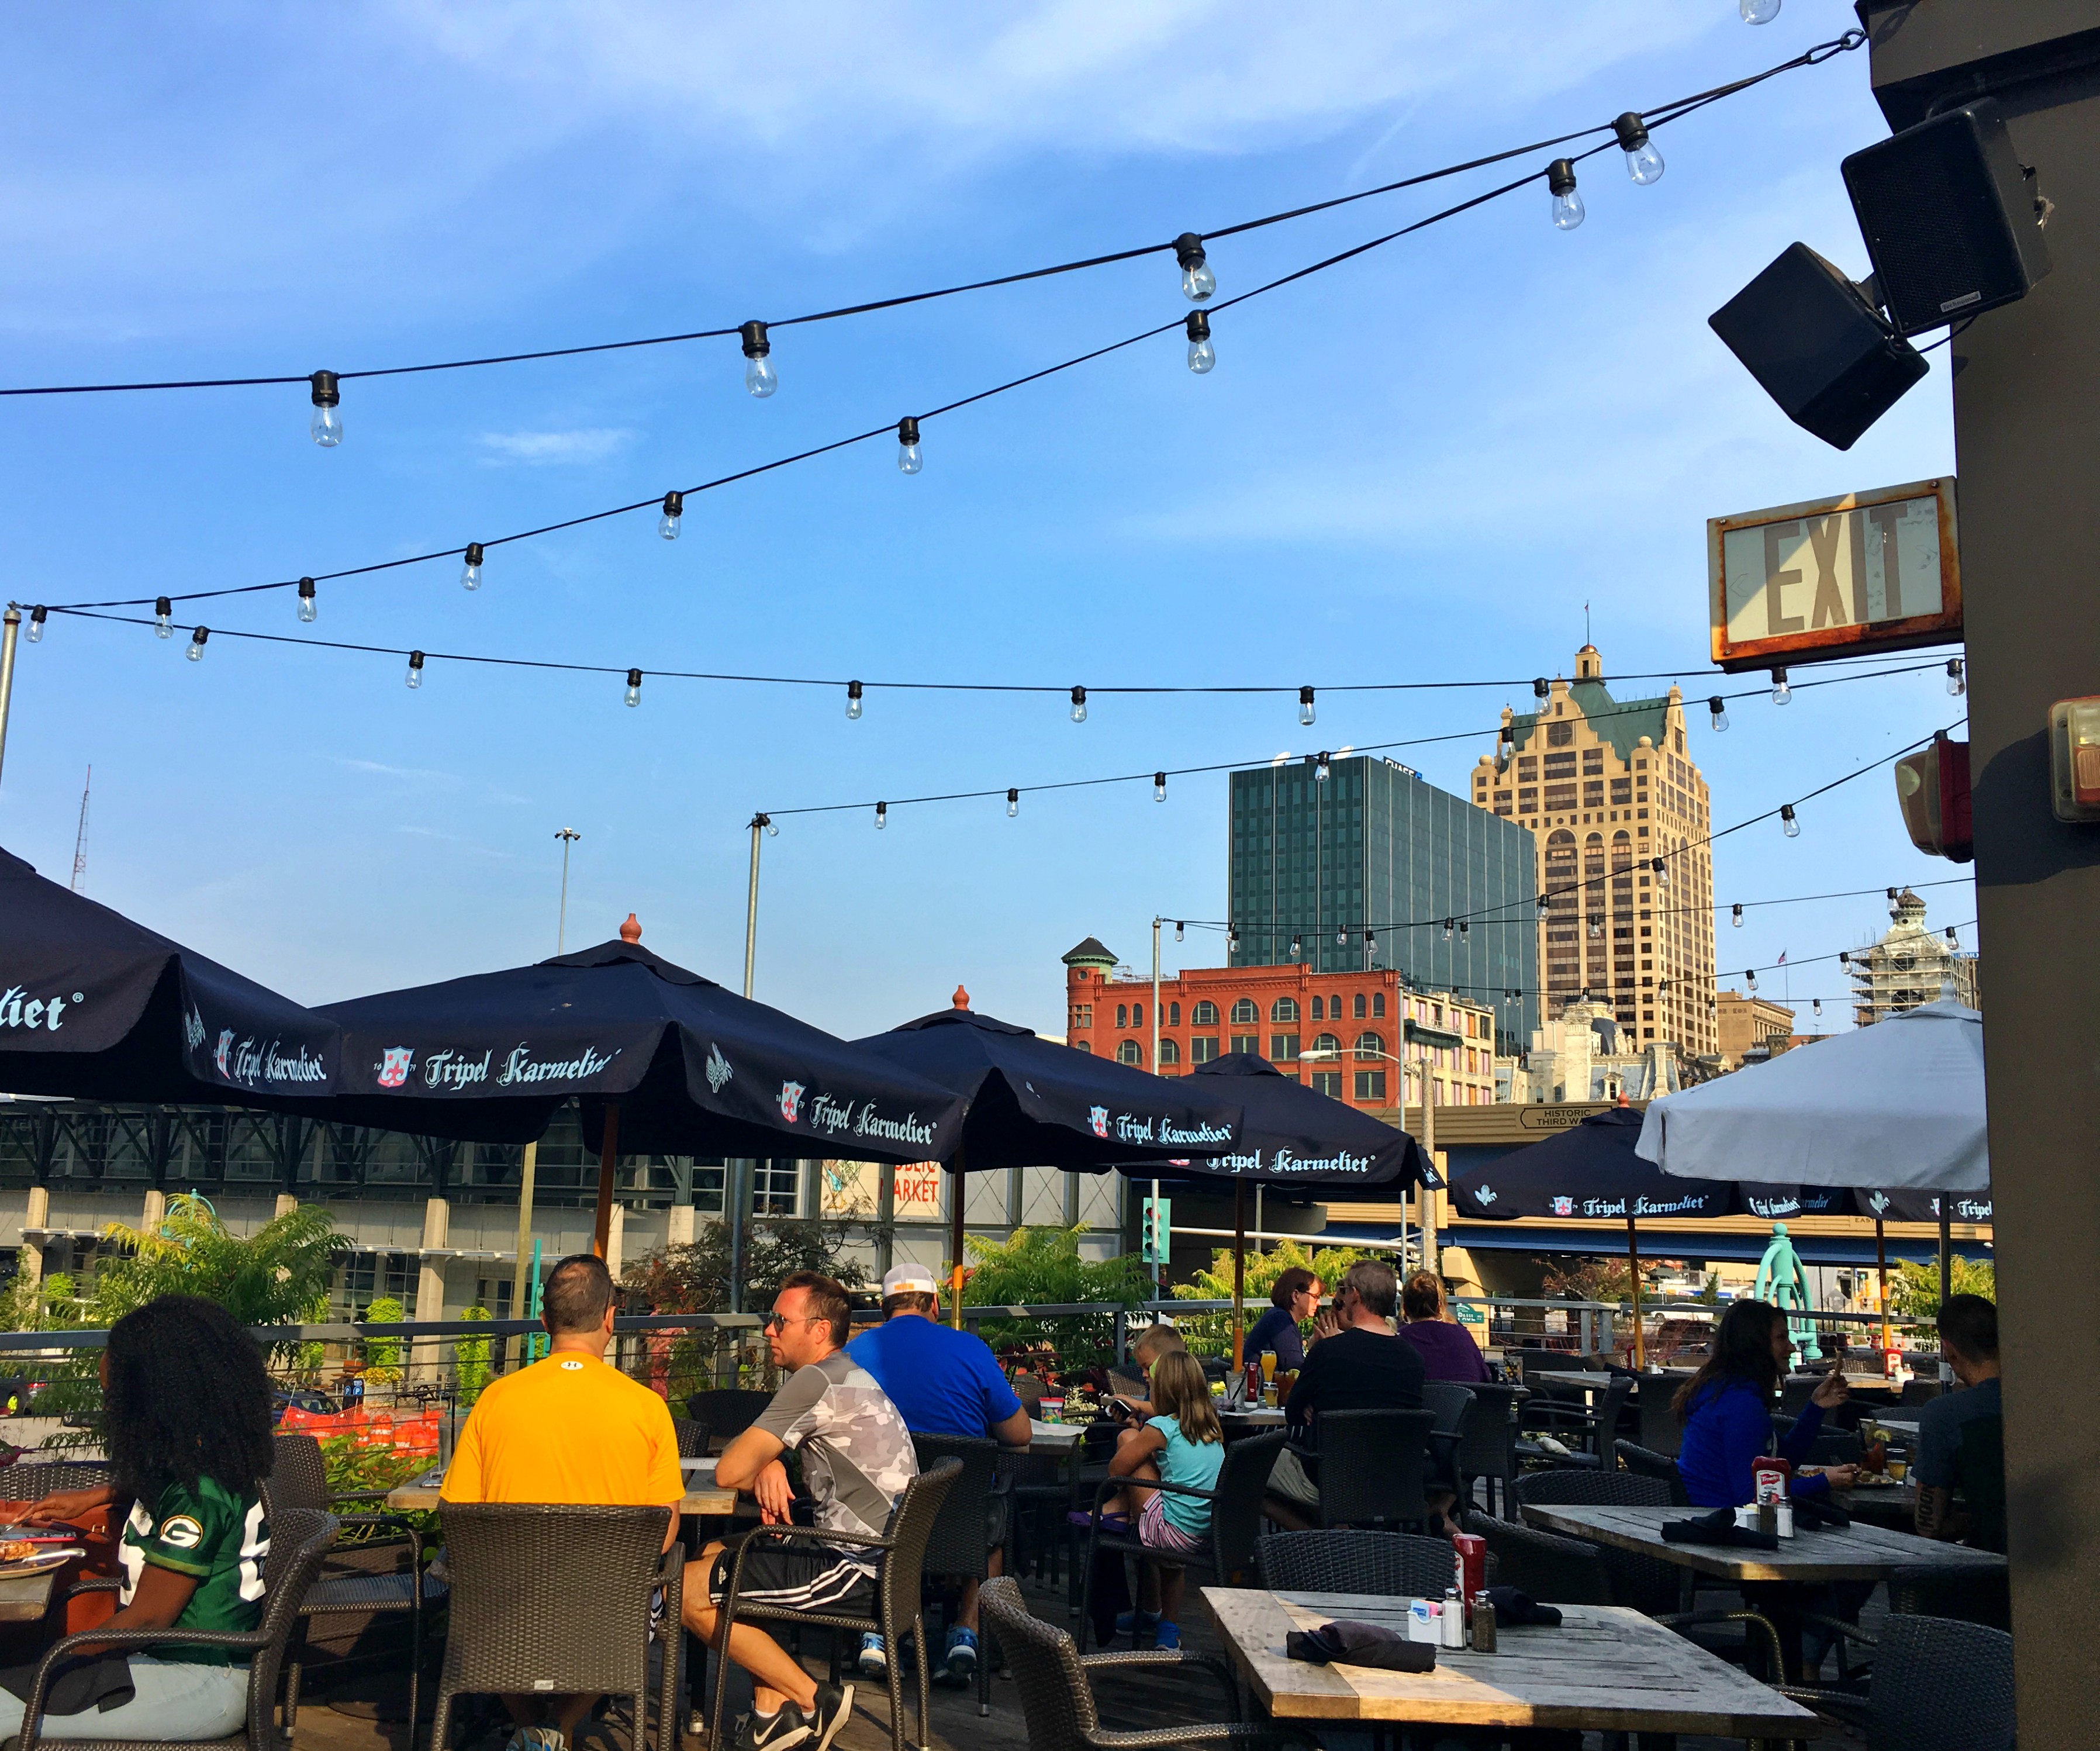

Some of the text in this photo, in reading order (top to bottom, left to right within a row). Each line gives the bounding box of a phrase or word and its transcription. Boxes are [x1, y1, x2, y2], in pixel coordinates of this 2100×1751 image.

[1764, 503, 1908, 635] EXIT
[426, 1048, 493, 1090] Tripel
[810, 1092, 932, 1145] Tripel Karmeliet
[1545, 1109, 1591, 1117] HISTORIC
[1116, 1112, 1232, 1144] Tripel Karmeliet
[1269, 1146, 1370, 1173] Karmeliet
[879, 1177, 938, 1203] ARKET
[1583, 1194, 1704, 1217] Tripel Karmeliet
[1957, 1199, 1992, 1220] Tripel
